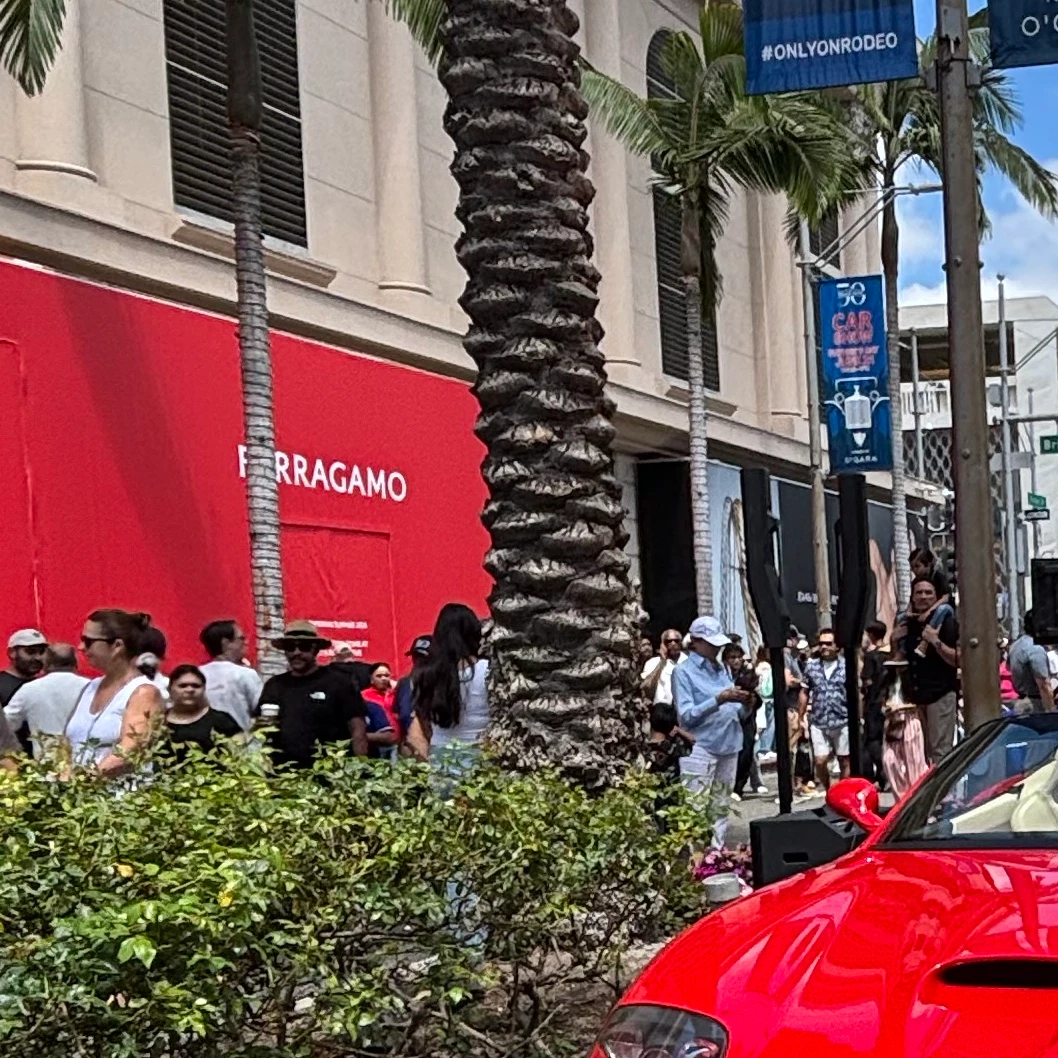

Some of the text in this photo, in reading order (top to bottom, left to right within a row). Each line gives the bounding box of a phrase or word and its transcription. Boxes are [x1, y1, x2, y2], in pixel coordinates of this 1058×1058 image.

[761, 32, 898, 62] #ONLYONRODEO
[831, 310, 873, 331] CAR
[237, 444, 407, 502] FRRAGAMO
